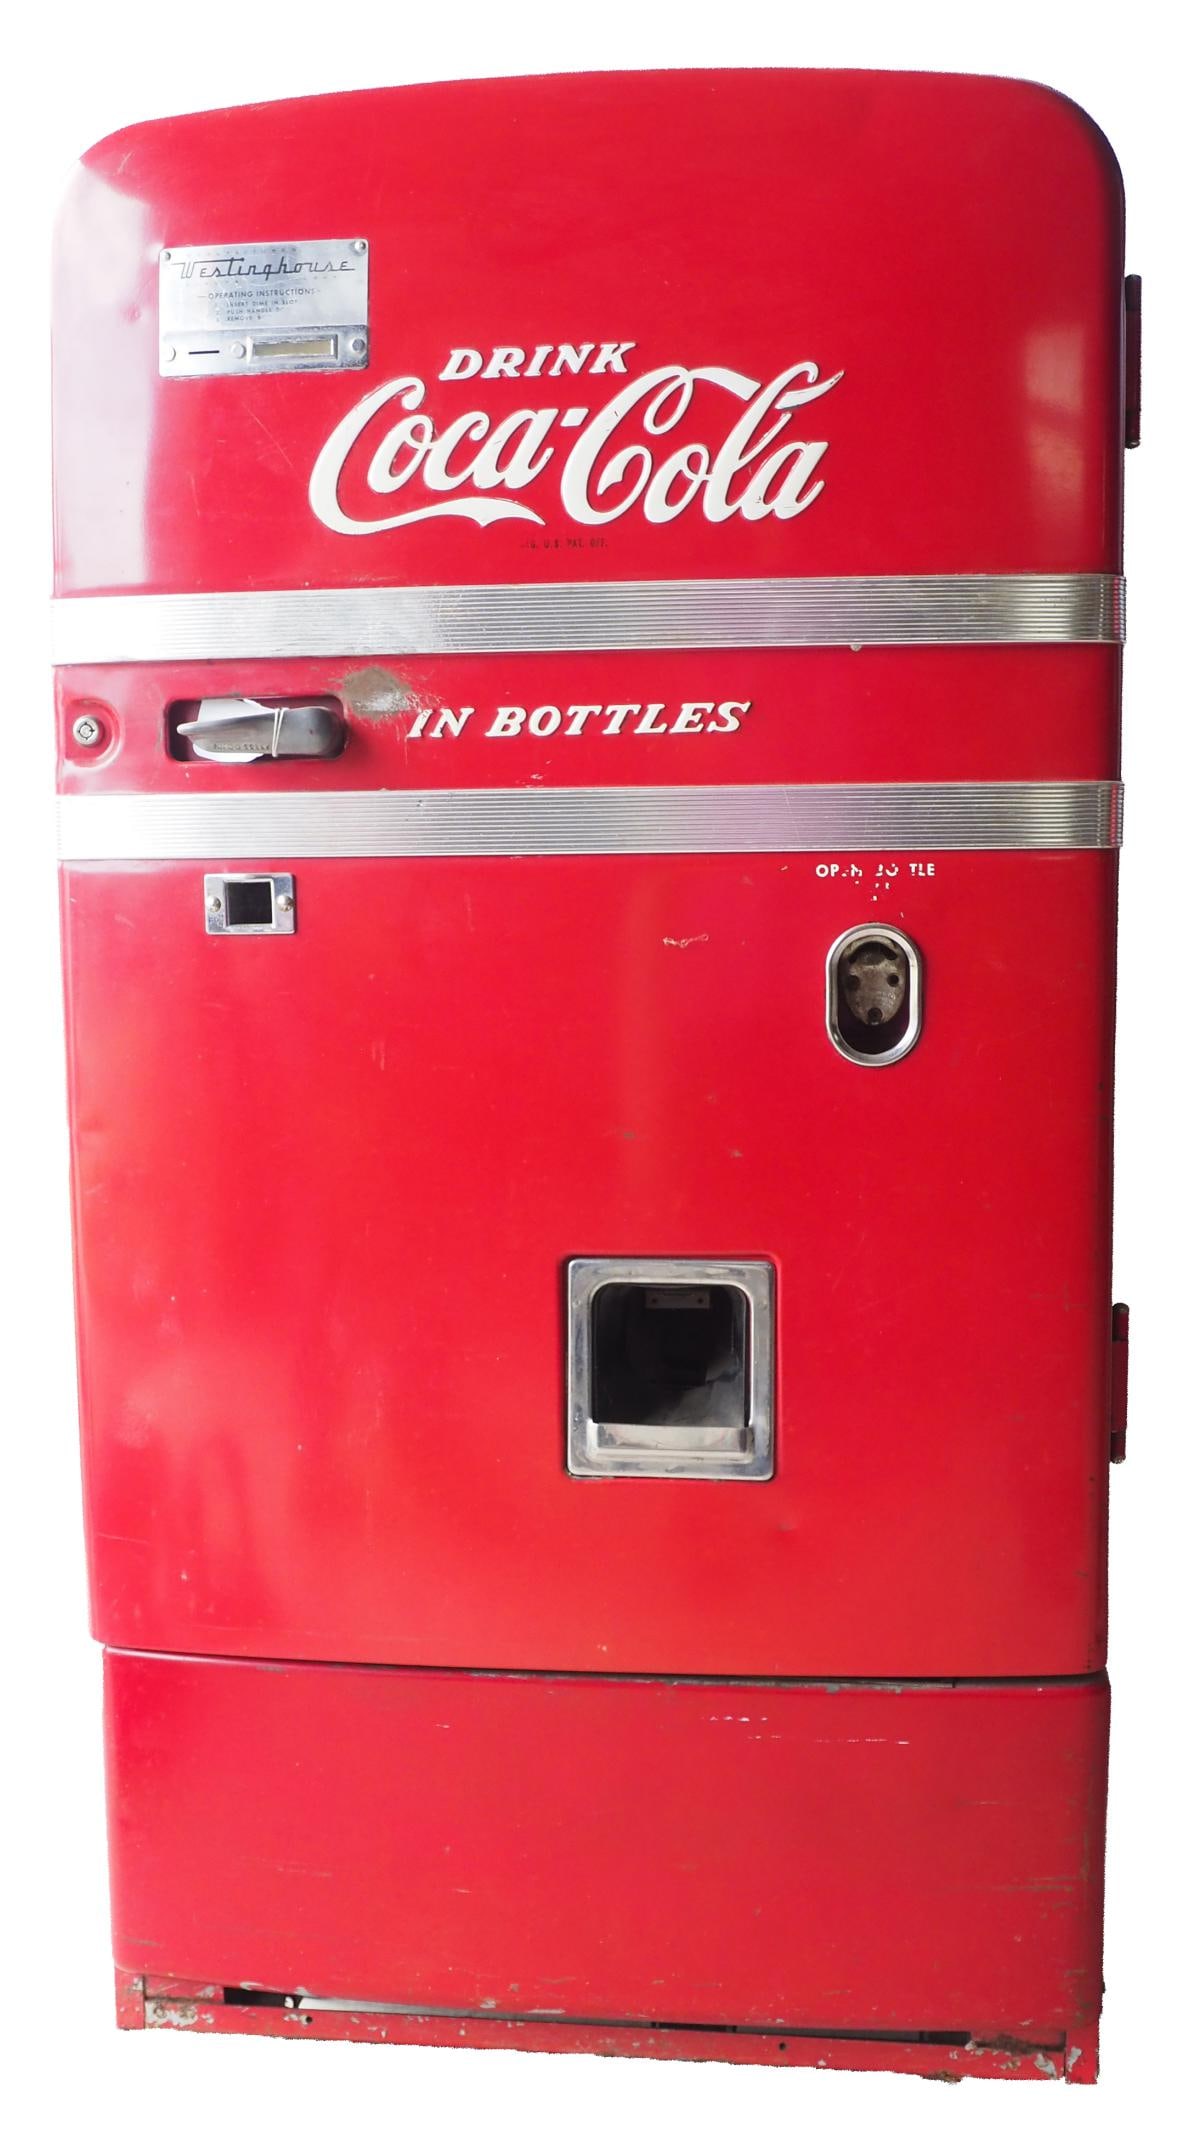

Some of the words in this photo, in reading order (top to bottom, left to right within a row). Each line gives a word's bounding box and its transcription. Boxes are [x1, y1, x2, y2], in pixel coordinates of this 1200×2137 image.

[172, 256, 355, 281] Westinghouse
[208, 290, 254, 299] OPERATING
[256, 288, 315, 297] INSTRUCTIONS
[439, 342, 636, 381] DRINK
[308, 361, 844, 535] Coca-Cola
[407, 708, 474, 738] IN
[485, 701, 751, 737] BOTTLES
